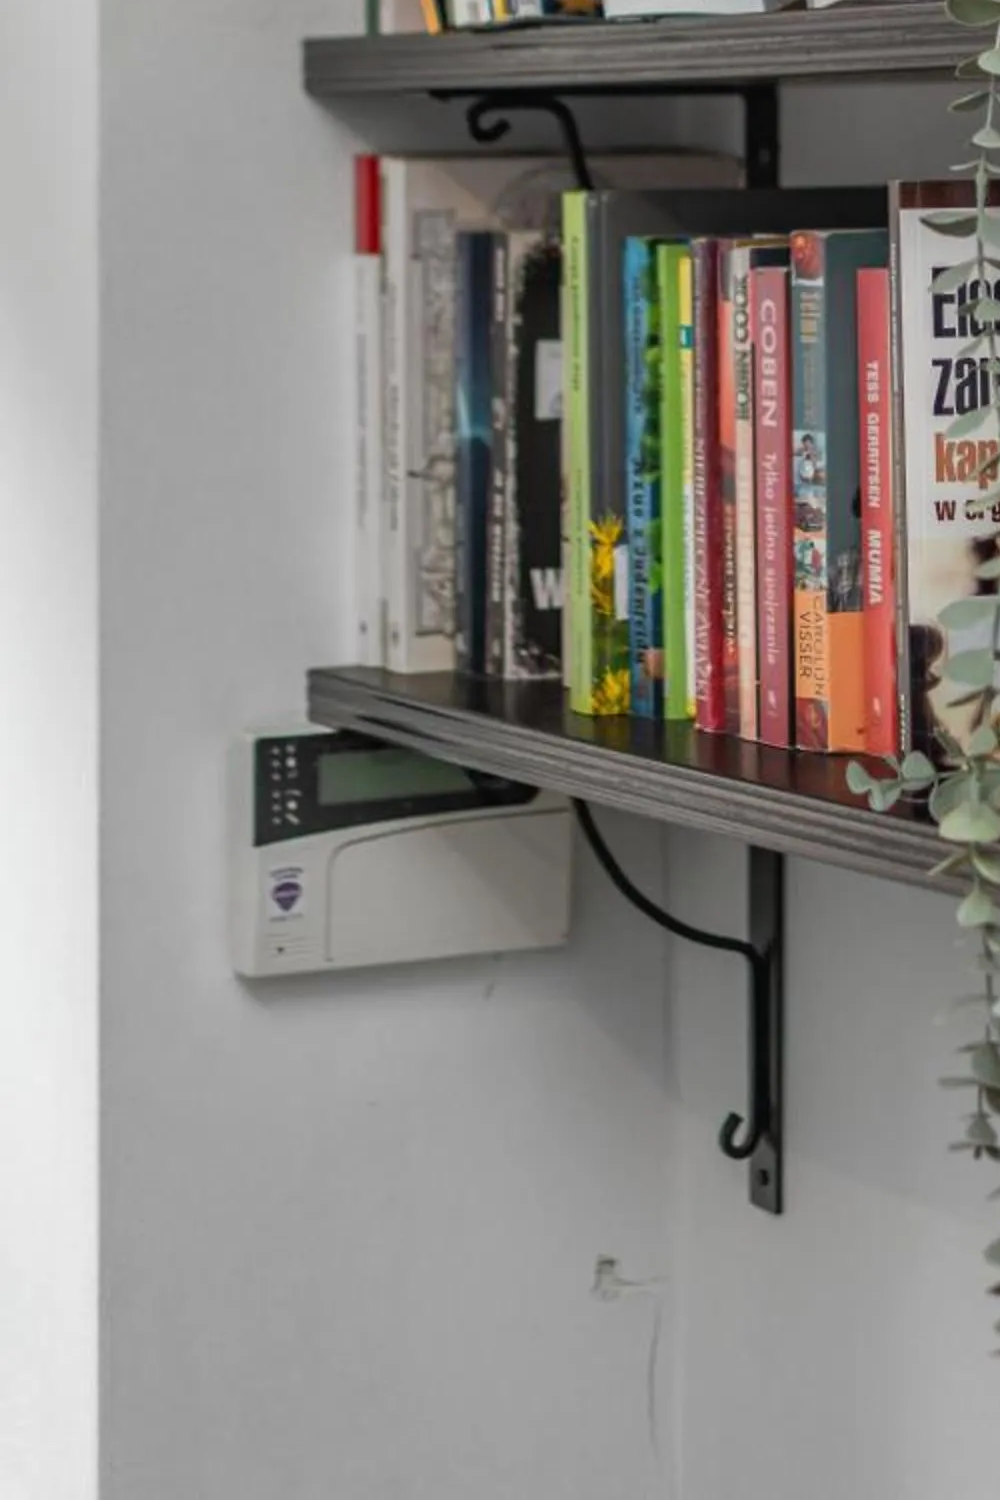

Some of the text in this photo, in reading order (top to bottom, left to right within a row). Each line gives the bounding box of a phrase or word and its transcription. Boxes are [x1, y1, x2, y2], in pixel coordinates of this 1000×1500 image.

[760, 298, 778, 428] COBEN
[867, 529, 883, 605] MUMIA
[799, 611, 814, 678] VISSER
